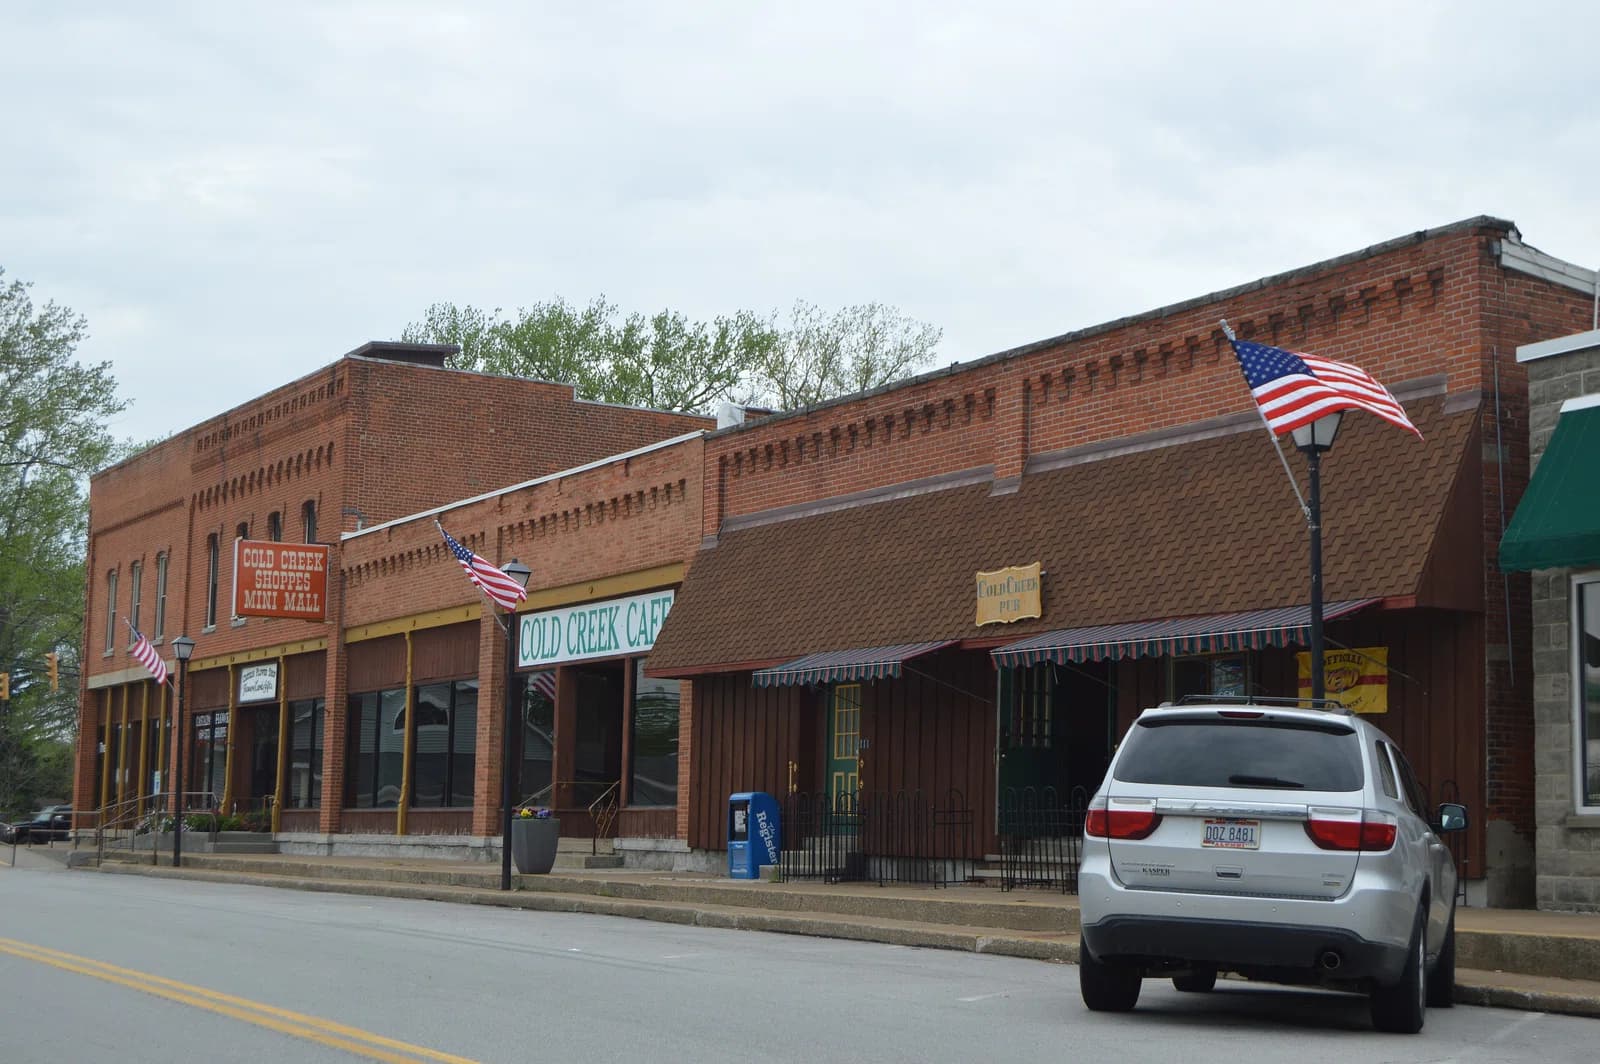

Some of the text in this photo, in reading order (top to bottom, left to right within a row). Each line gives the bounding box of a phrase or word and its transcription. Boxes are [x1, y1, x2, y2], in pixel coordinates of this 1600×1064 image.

[243, 548, 324, 572] COLD CREEK
[255, 569, 311, 591] SHOPPES
[978, 579, 1006, 598] COLD
[243, 590, 320, 612] MINI MALL
[999, 598, 1020, 613] PUB
[521, 616, 562, 661] COLD
[566, 605, 621, 656] CREEK
[1323, 653, 1363, 666] FFICIAL
[756, 810, 778, 864] Register
[1228, 827, 1254, 842] 8481
[1142, 867, 1171, 875] KASPER
